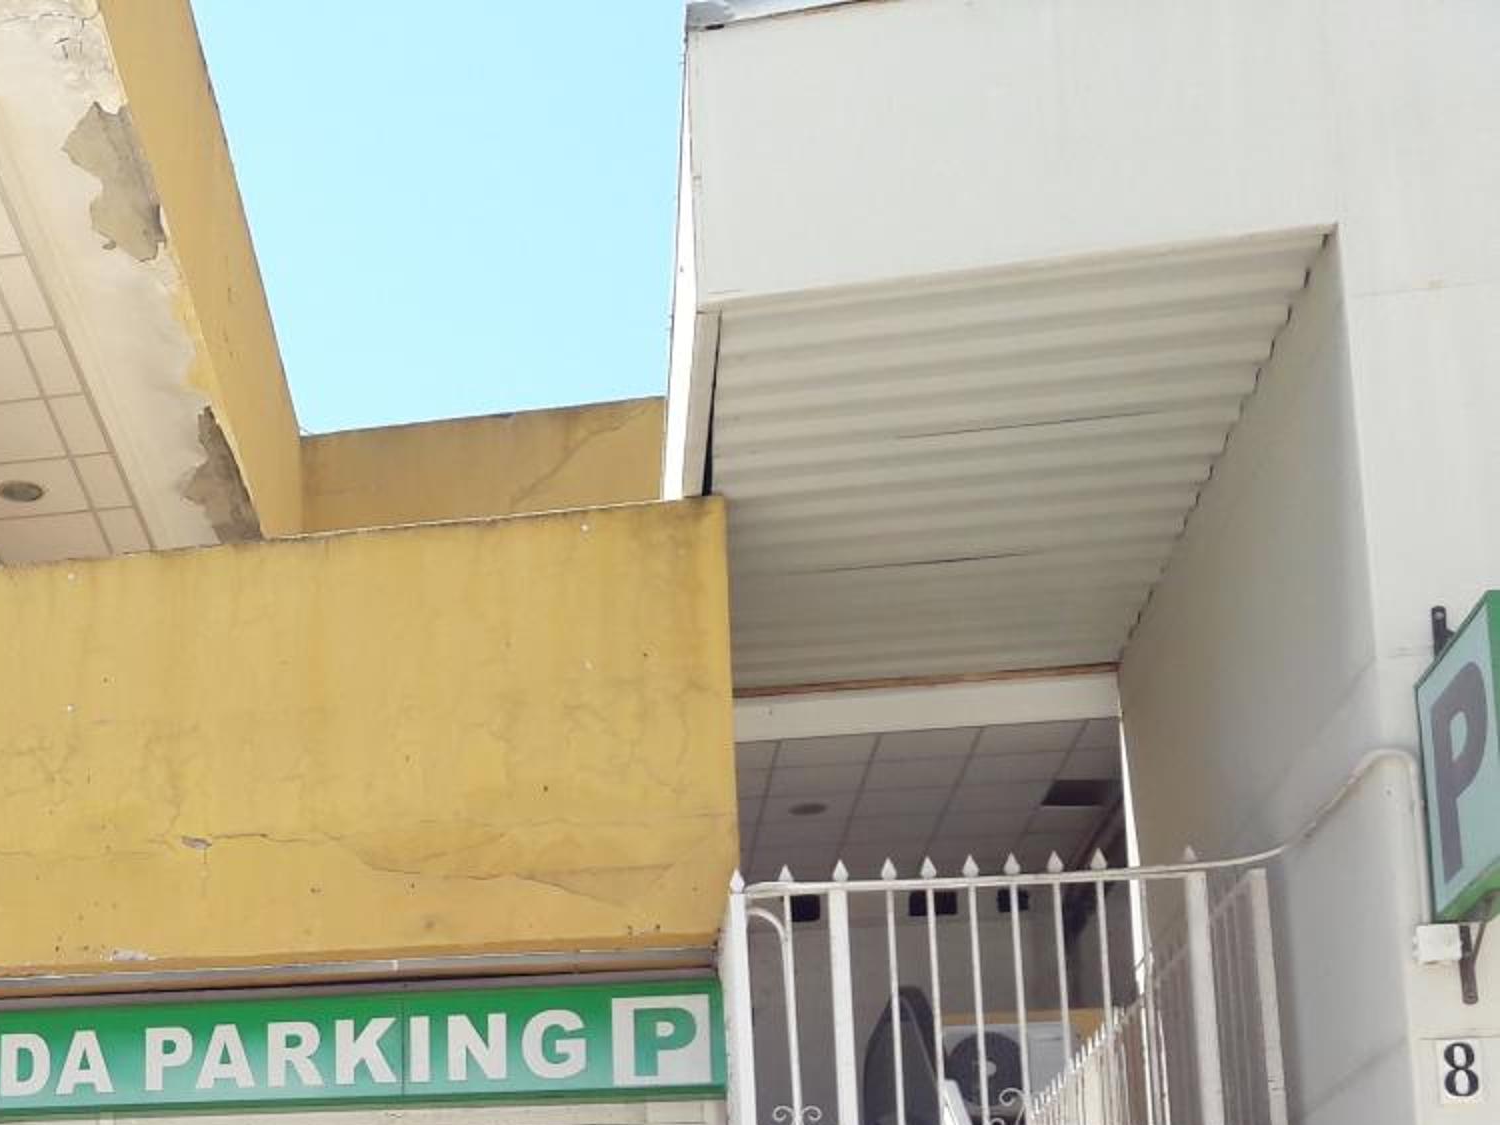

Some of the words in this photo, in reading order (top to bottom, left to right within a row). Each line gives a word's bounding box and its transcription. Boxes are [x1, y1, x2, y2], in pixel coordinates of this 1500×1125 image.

[1431, 661, 1488, 884] P
[145, 1009, 588, 1091] PARKING
[633, 1007, 696, 1076] P
[1443, 1042, 1480, 1097] 8
